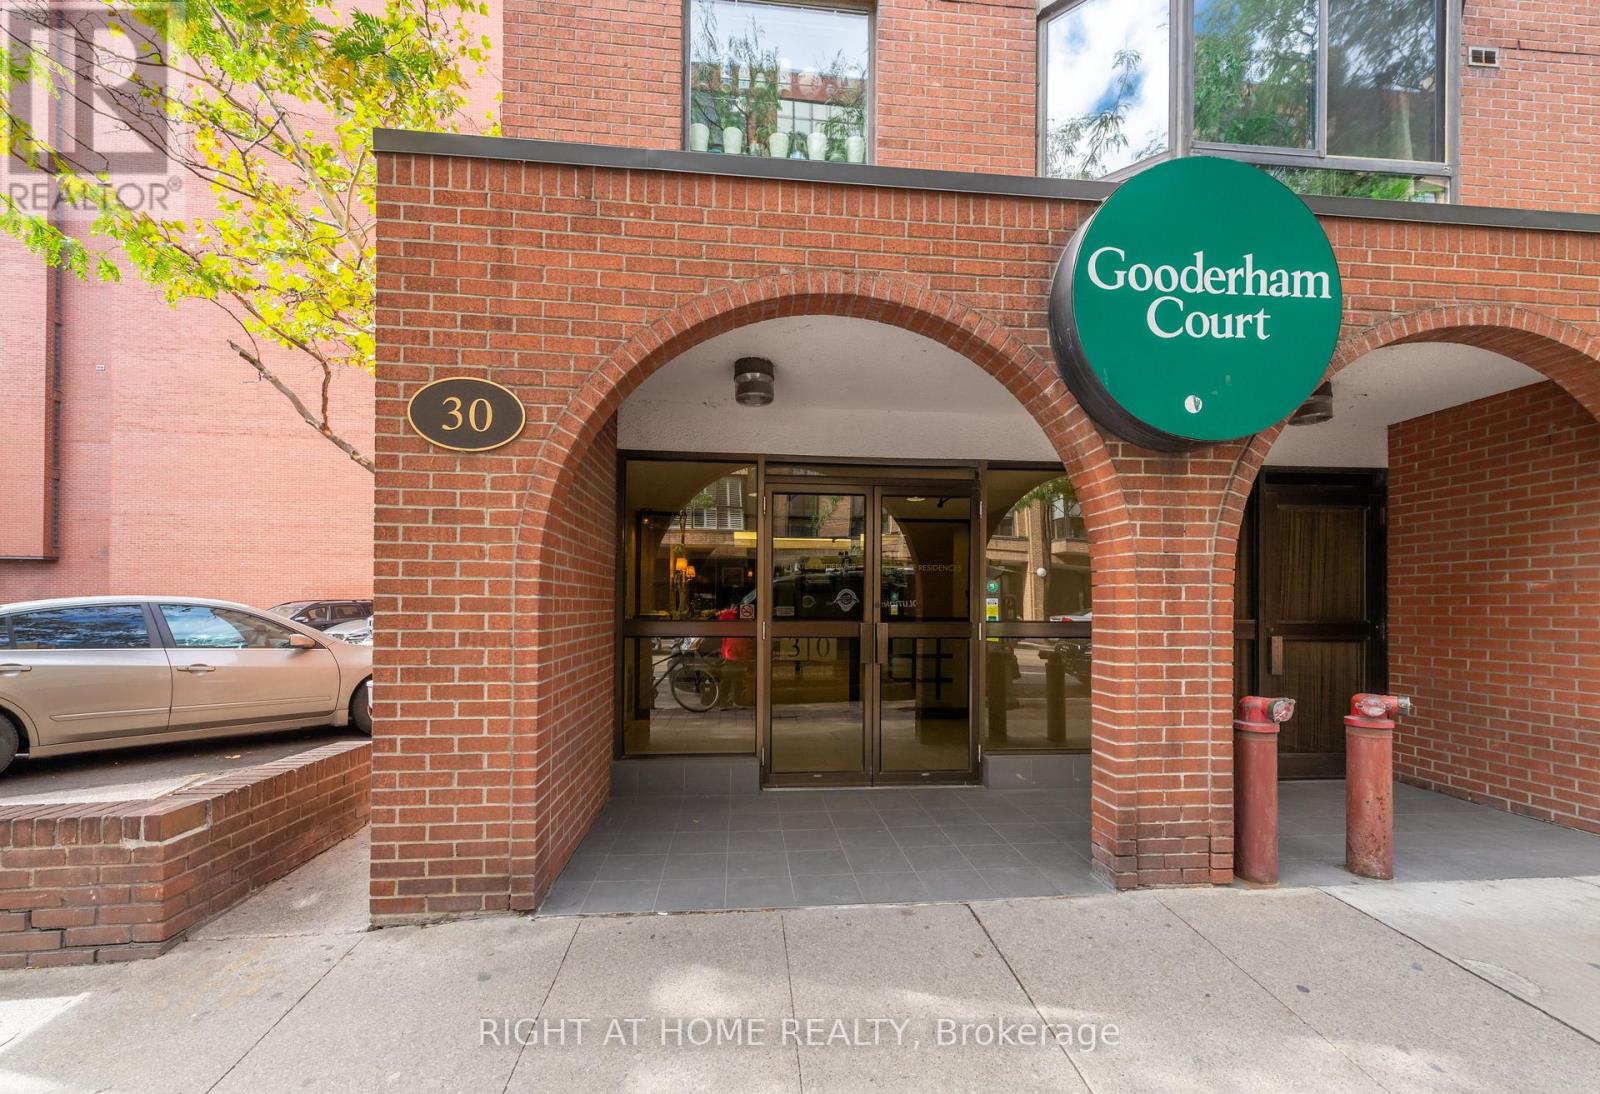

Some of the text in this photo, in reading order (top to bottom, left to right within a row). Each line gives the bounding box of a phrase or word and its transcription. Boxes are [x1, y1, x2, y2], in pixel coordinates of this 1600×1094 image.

[1087, 246, 1332, 298] Gooderham
[1146, 296, 1271, 340] Court
[442, 396, 493, 432] 30
